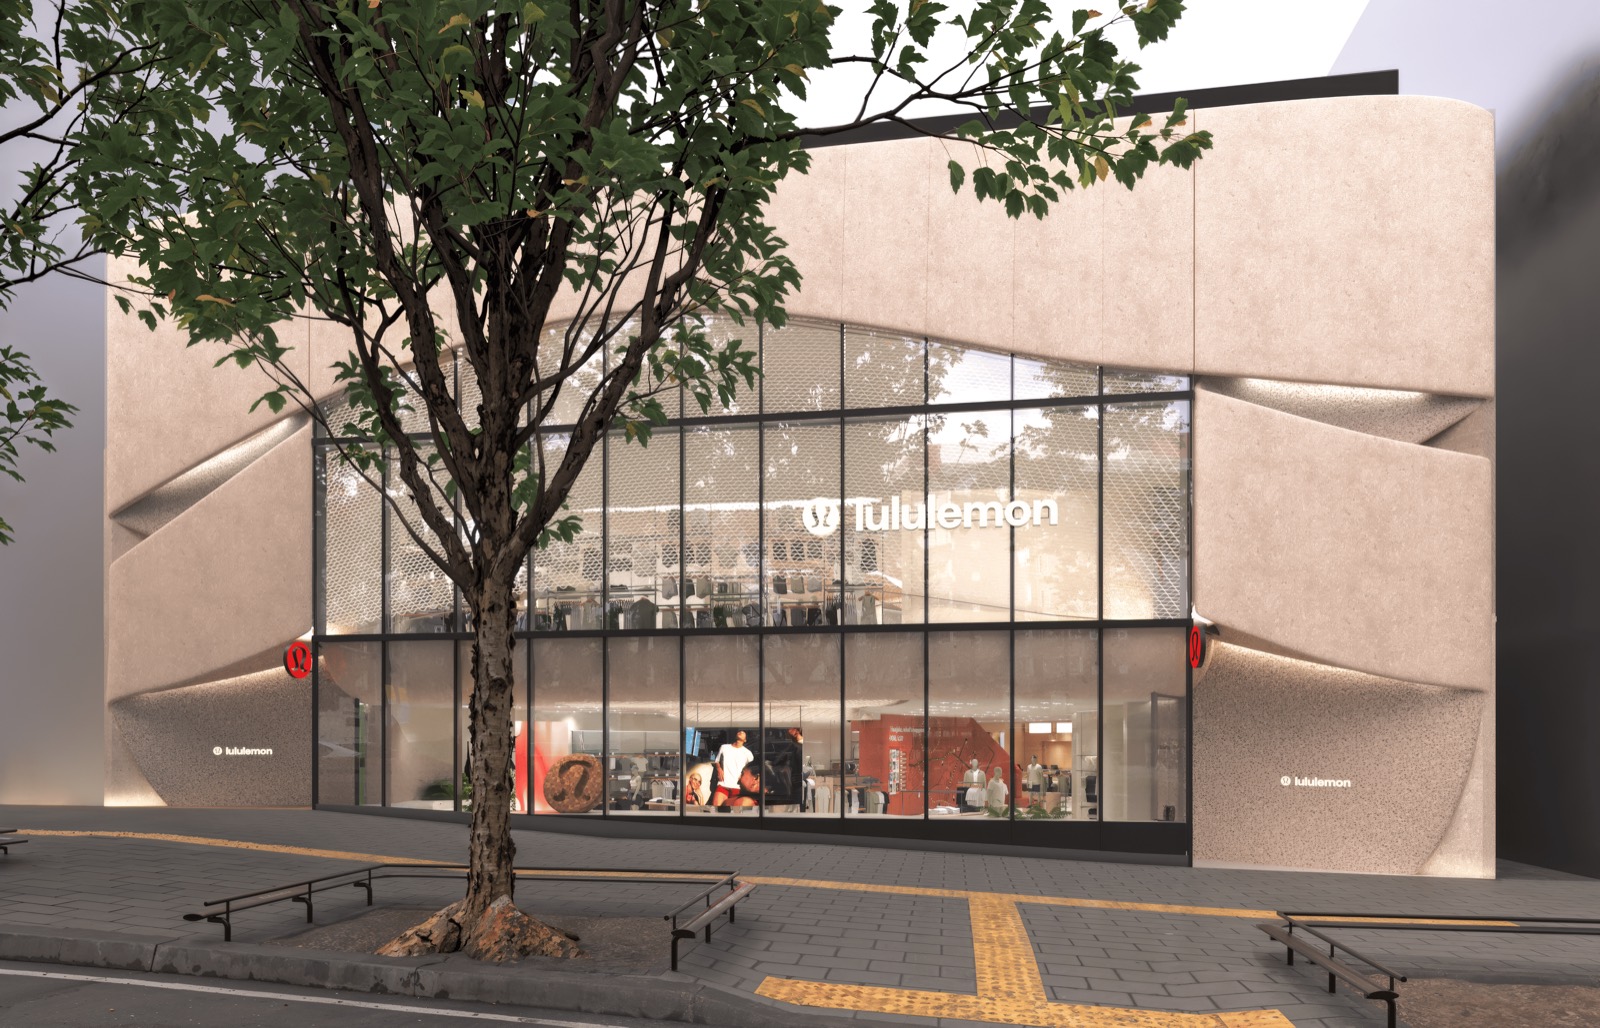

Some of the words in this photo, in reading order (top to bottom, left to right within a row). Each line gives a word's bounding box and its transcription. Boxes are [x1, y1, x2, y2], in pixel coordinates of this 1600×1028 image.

[855, 495, 1058, 531] lululemon
[225, 746, 273, 756] lululemon
[1294, 776, 1352, 788] lululemon
